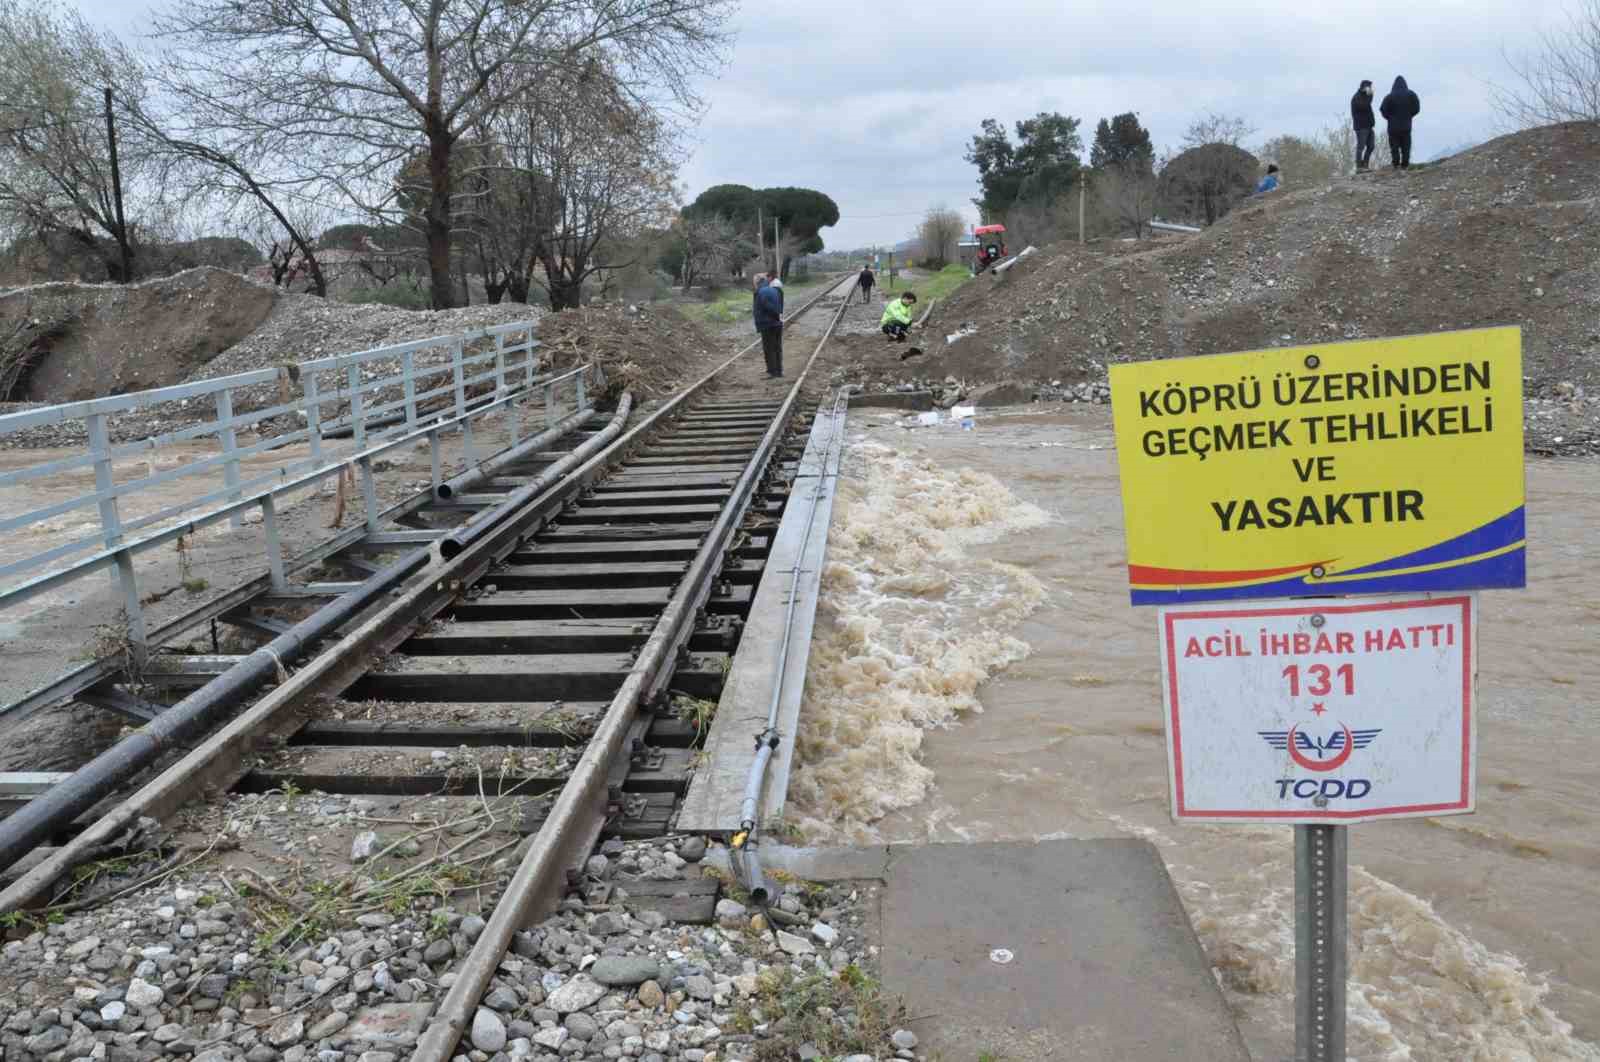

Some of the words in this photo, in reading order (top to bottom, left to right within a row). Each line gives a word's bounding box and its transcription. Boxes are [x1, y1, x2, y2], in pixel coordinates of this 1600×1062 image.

[1139, 376, 1262, 418] KÖPRÜ
[1272, 361, 1491, 406] ÜZERİNDEN
[1142, 419, 1292, 461] GEÇMEK
[1300, 397, 1493, 445] TEHLİKELİ
[1292, 456, 1337, 483] VE
[1211, 489, 1425, 532] YASAKTIR
[1184, 629, 1252, 657] ACİL
[1260, 628, 1355, 655] İHBAR
[1364, 623, 1454, 652] HATTI
[1282, 663, 1355, 696] 131
[1275, 779, 1372, 800] TCDD
